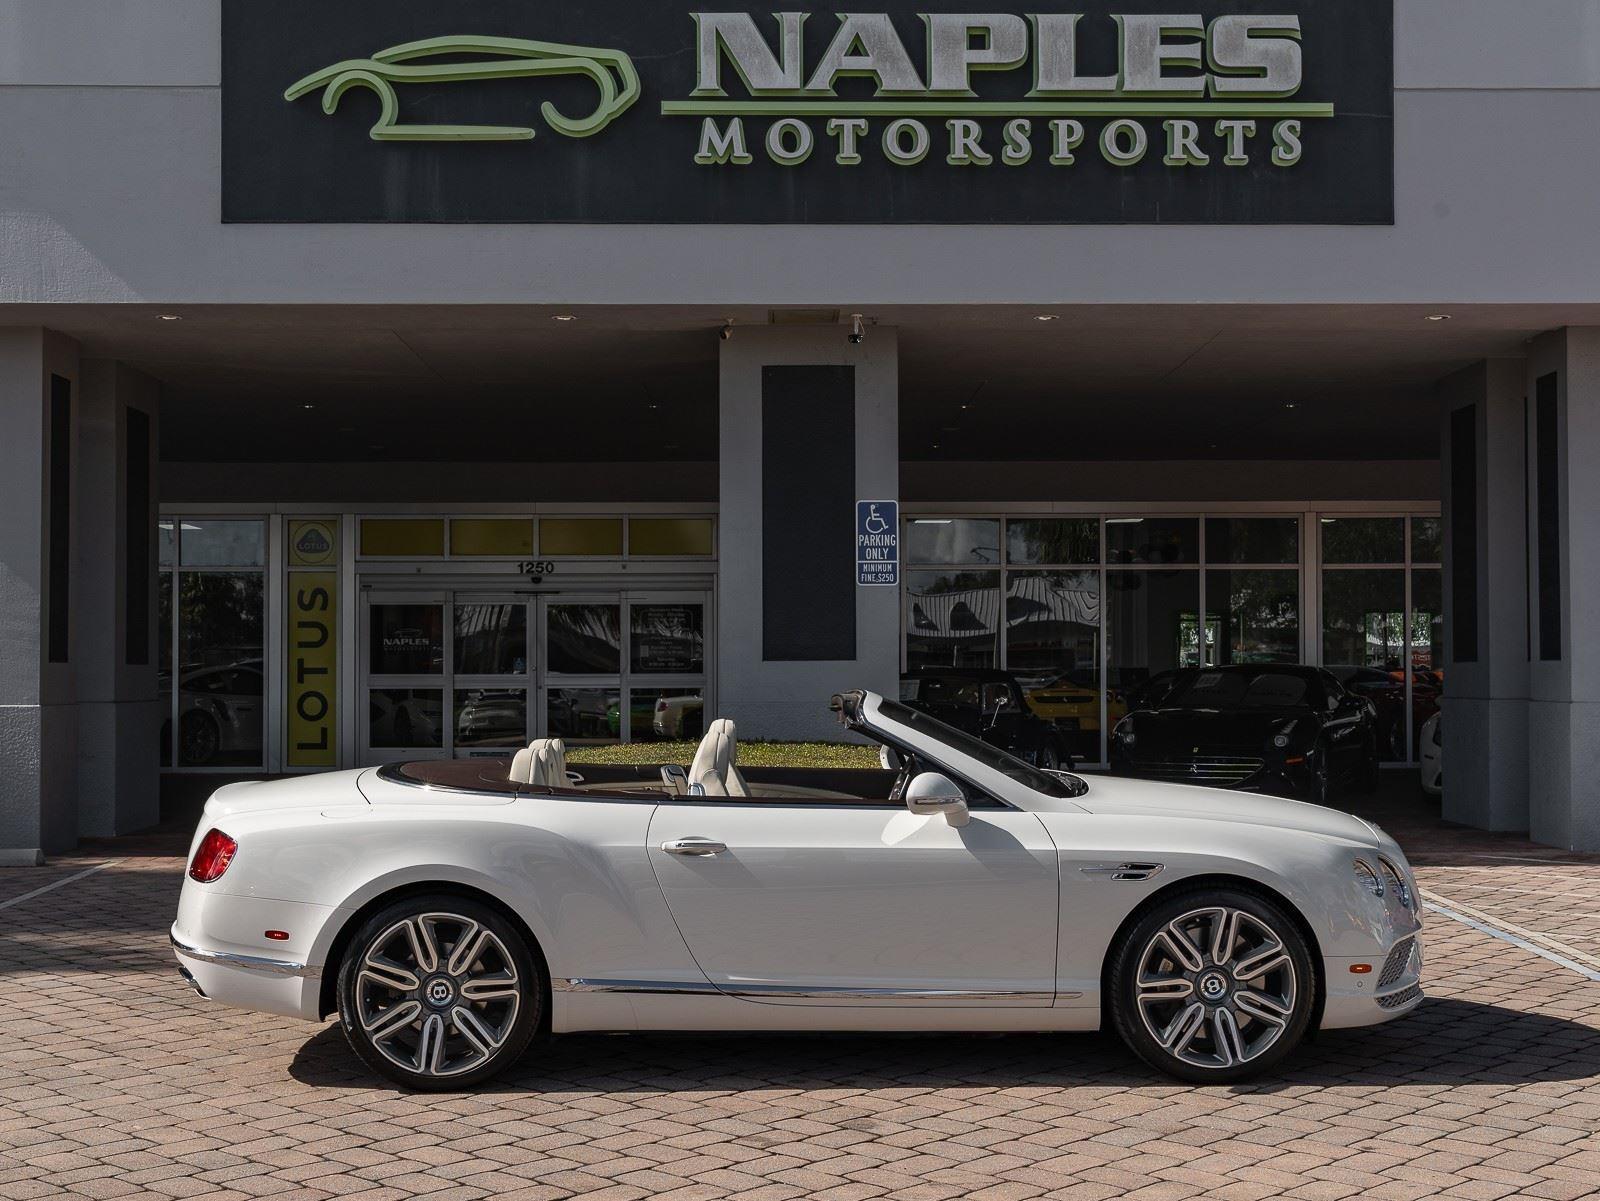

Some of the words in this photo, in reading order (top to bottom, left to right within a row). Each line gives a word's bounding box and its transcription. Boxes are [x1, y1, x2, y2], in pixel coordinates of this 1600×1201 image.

[690, 12, 1303, 98] NAPLES
[694, 117, 1303, 166] MOTORSPORTS
[858, 534, 896, 546] PARKING
[866, 548, 888, 559] ONLY
[517, 561, 555, 574] 1250
[863, 564, 892, 572] MINIMUM
[861, 573, 876, 582] FINE
[877, 573, 894, 582] $250
[383, 637, 430, 646] NAPLES
[297, 587, 328, 750] LOTUS
